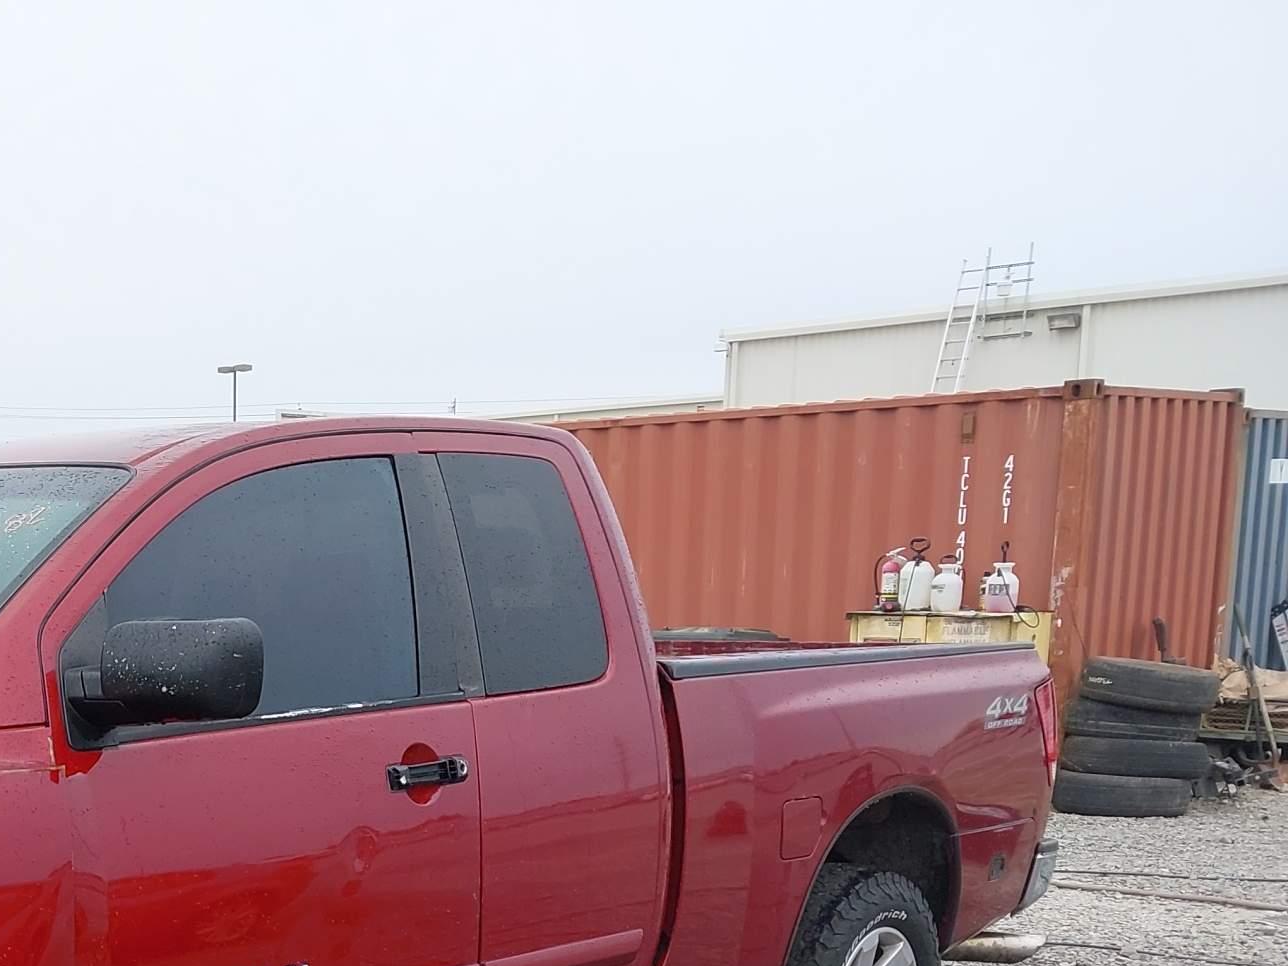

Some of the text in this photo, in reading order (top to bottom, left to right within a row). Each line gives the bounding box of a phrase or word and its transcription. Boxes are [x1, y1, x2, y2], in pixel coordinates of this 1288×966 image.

[955, 456, 972, 570] TCLU 40
[1002, 454, 1015, 525] 42G1
